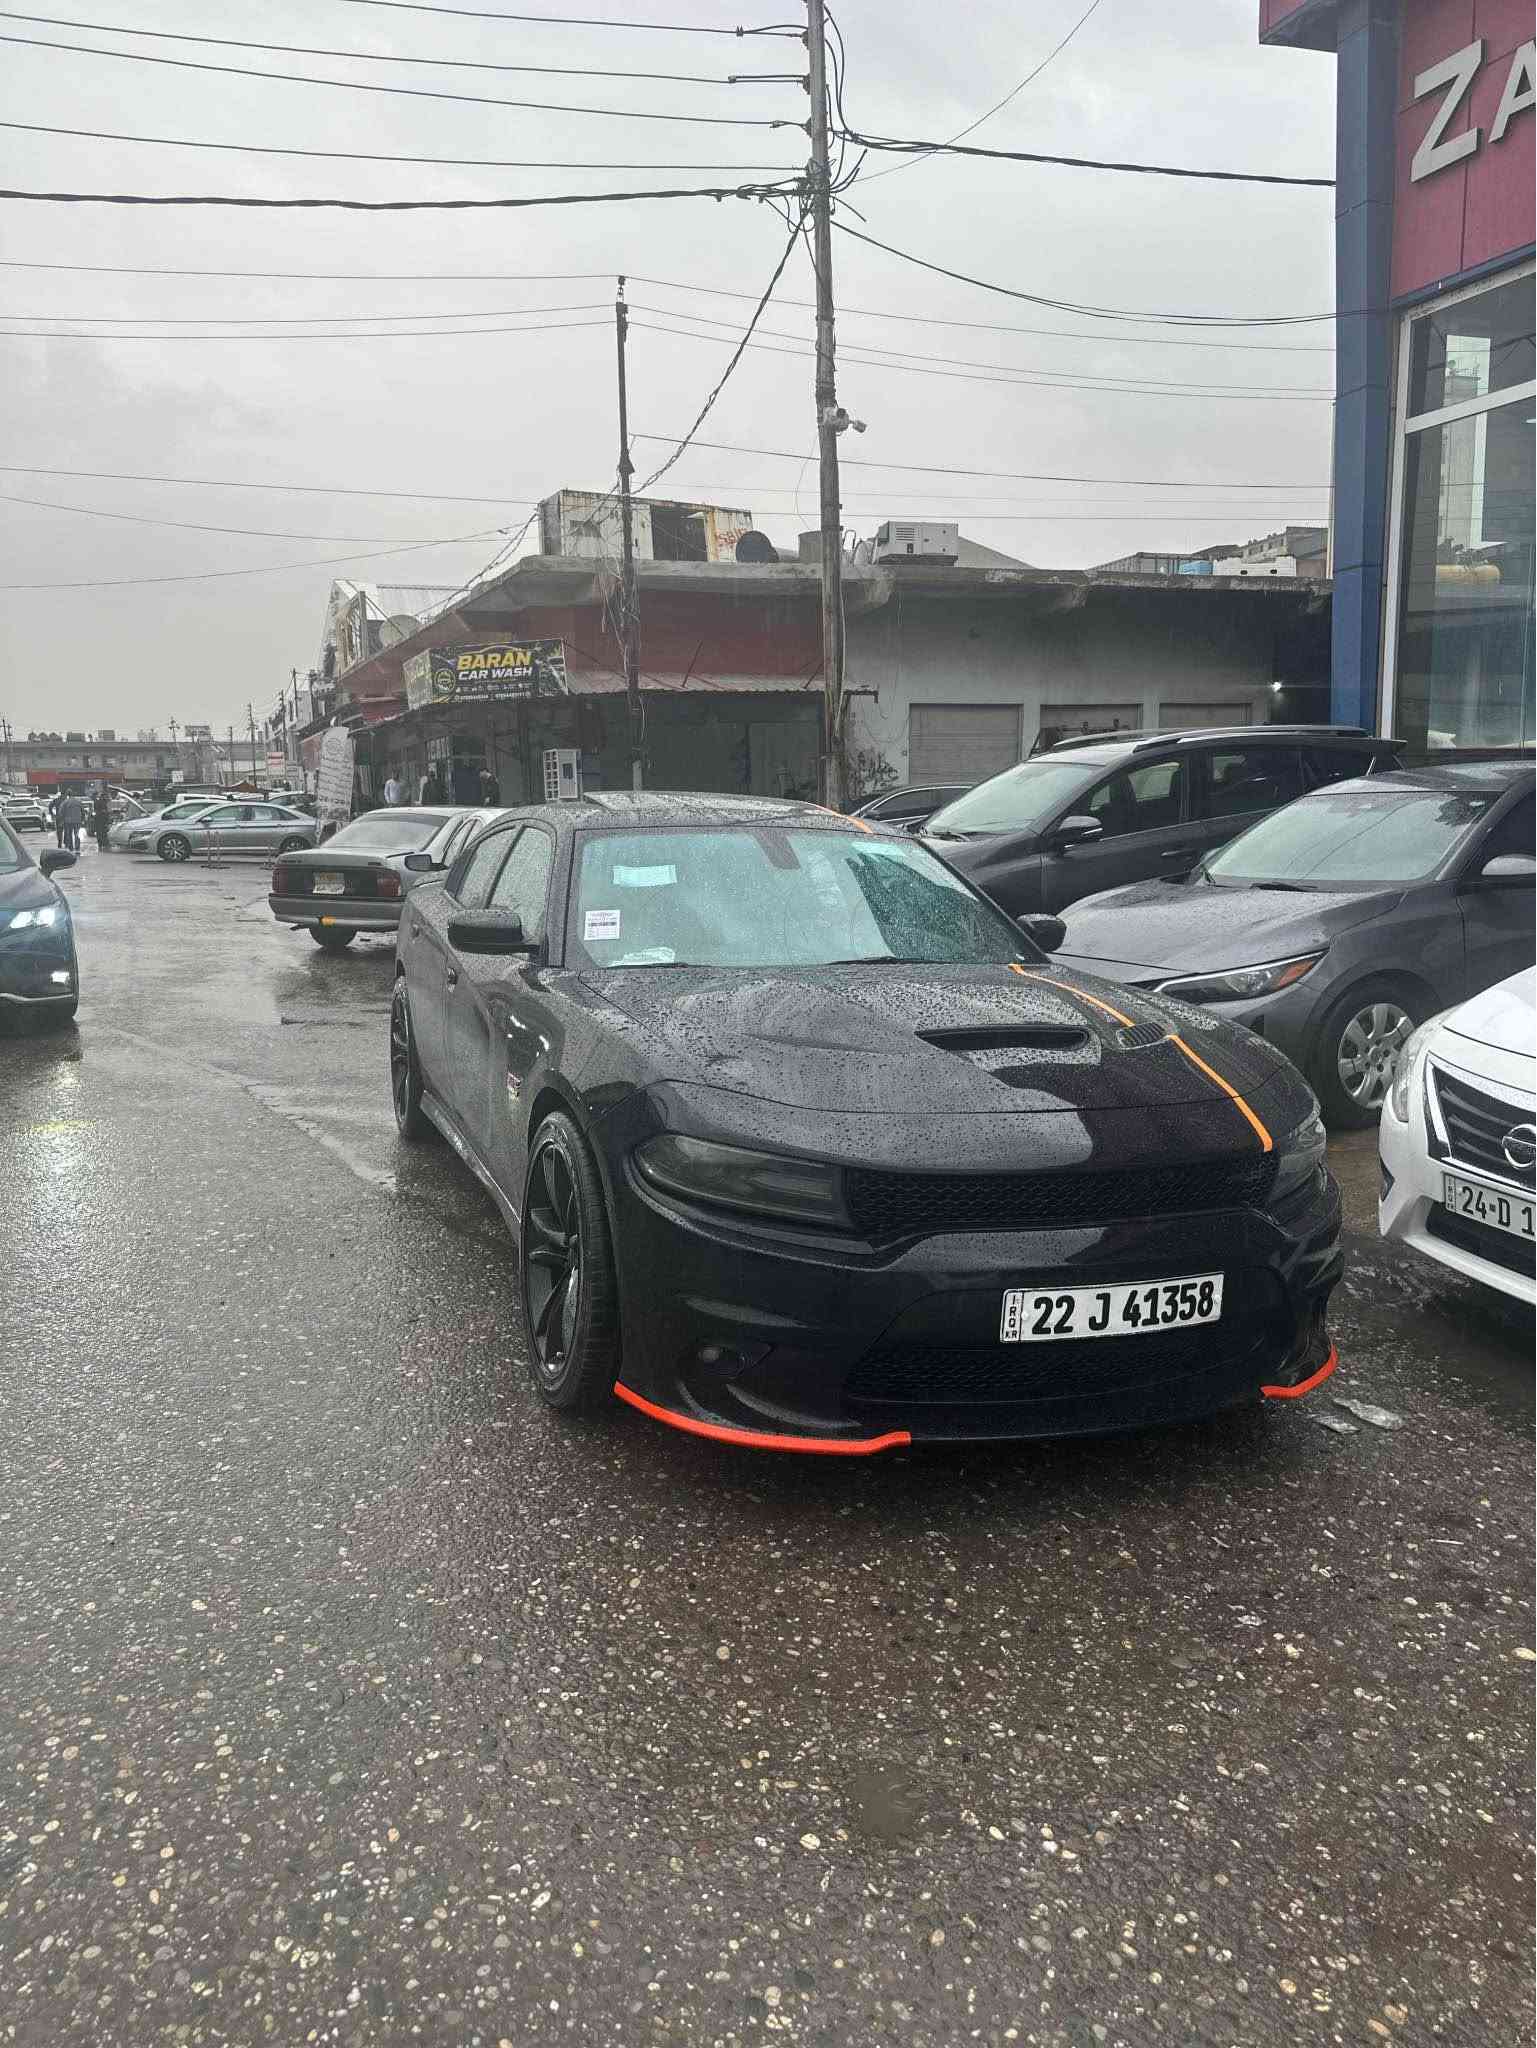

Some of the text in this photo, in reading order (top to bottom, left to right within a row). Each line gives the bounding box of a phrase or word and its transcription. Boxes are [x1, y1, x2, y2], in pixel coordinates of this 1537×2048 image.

[1411, 39, 1536, 183] ZA
[457, 651, 531, 670] BARAN
[458, 670, 488, 680] CAR
[491, 667, 533, 678] WASH
[1031, 1281, 1215, 1335] 22 J 41358
